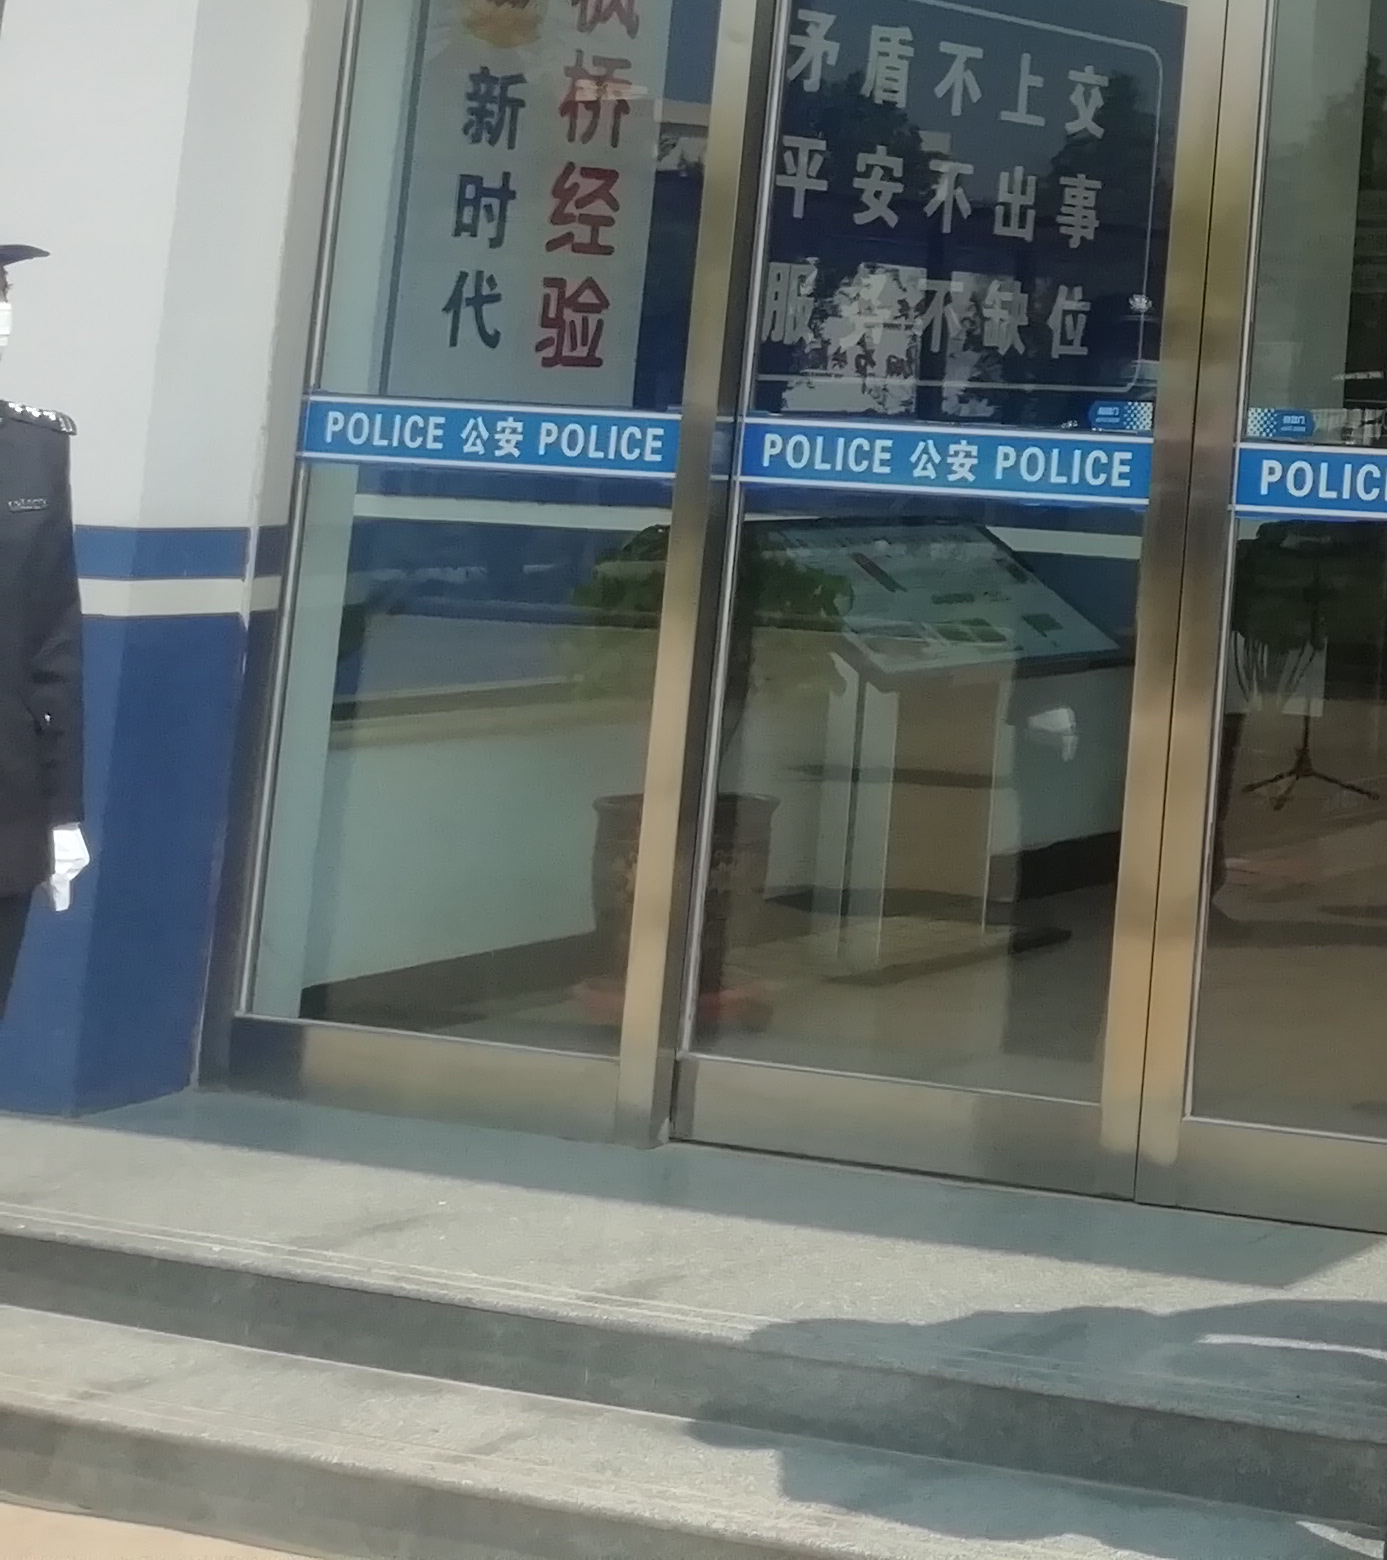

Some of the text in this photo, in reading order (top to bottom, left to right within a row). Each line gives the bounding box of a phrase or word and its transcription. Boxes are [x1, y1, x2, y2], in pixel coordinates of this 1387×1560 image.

[786, 8, 1109, 139] 矛盾不上交
[441, 65, 527, 350] 新时代
[775, 134, 1103, 249] 平安不出事
[325, 410, 665, 462] POLICE 公安 POLICE
[762, 433, 1133, 487] POLICE 公安 POLICE
